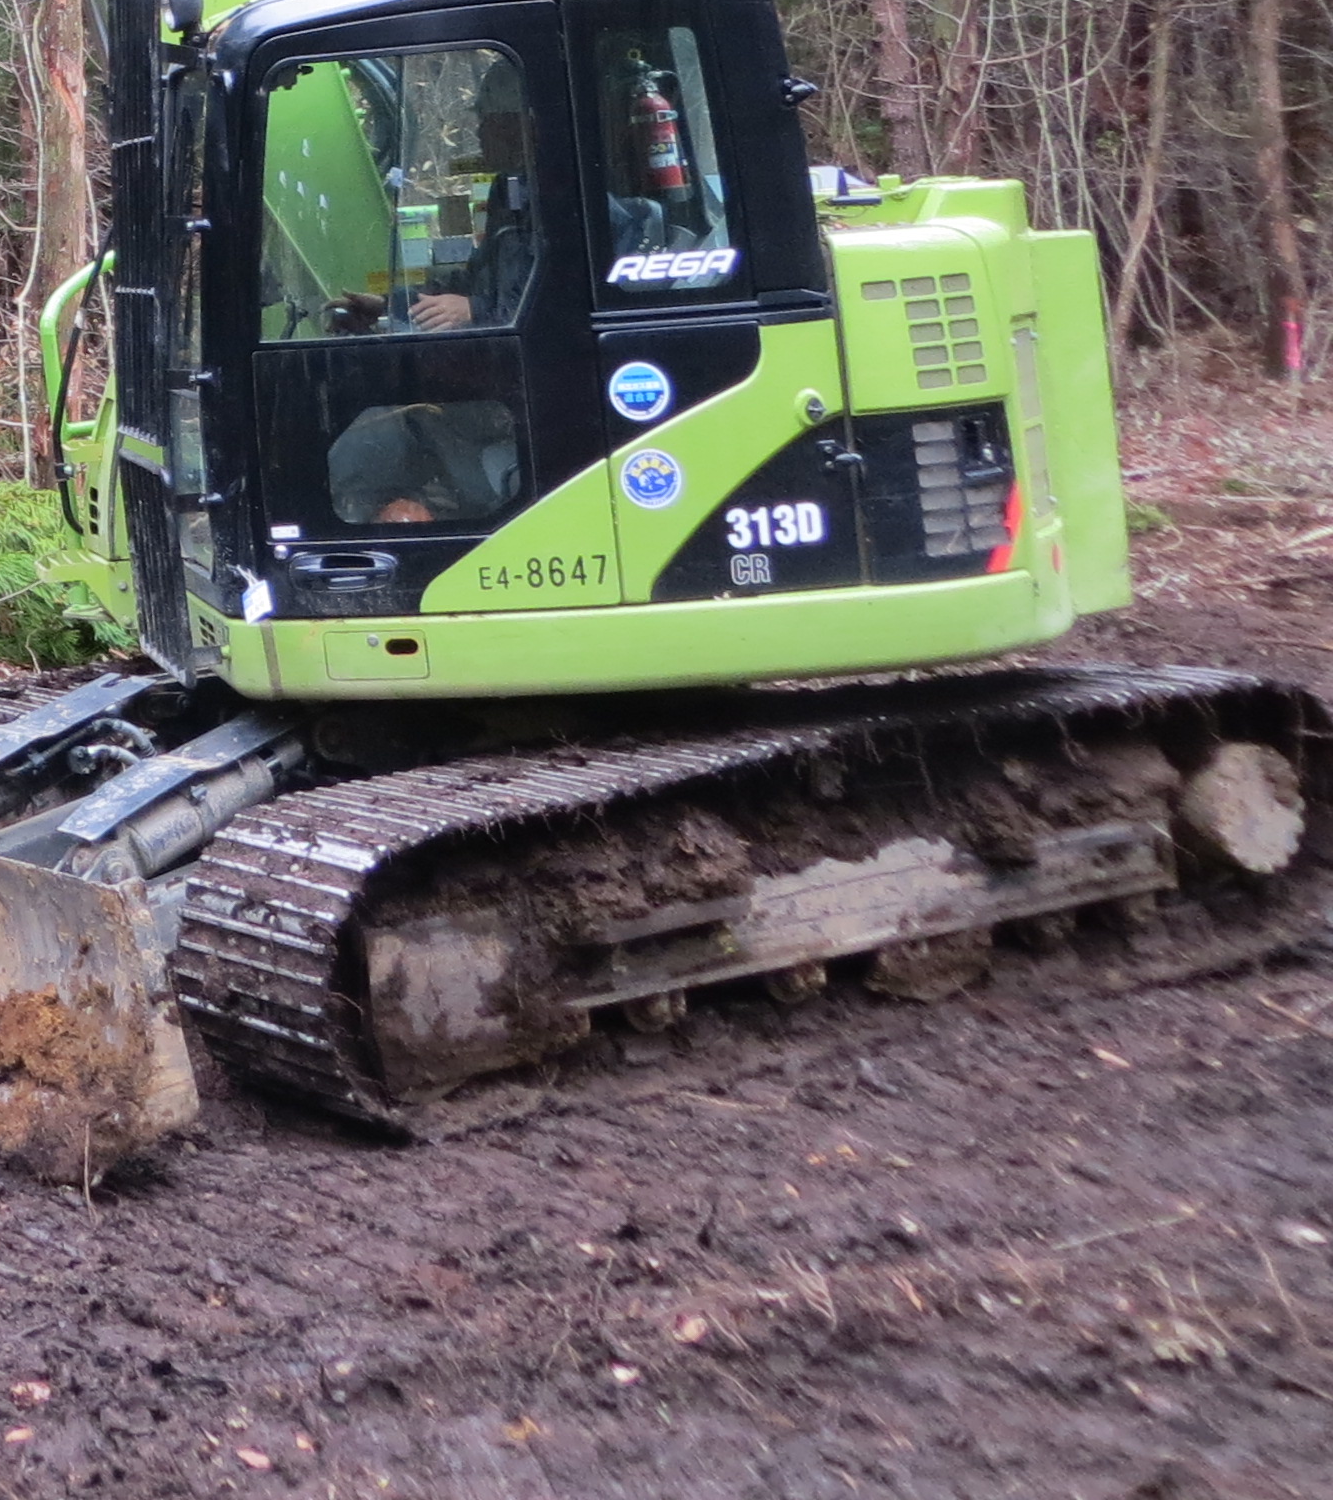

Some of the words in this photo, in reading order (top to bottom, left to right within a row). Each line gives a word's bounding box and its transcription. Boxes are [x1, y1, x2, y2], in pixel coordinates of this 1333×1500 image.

[606, 248, 736, 283] REGA
[725, 502, 823, 549] 313D
[478, 554, 607, 590] E4-8647
[730, 553, 772, 586] CR
